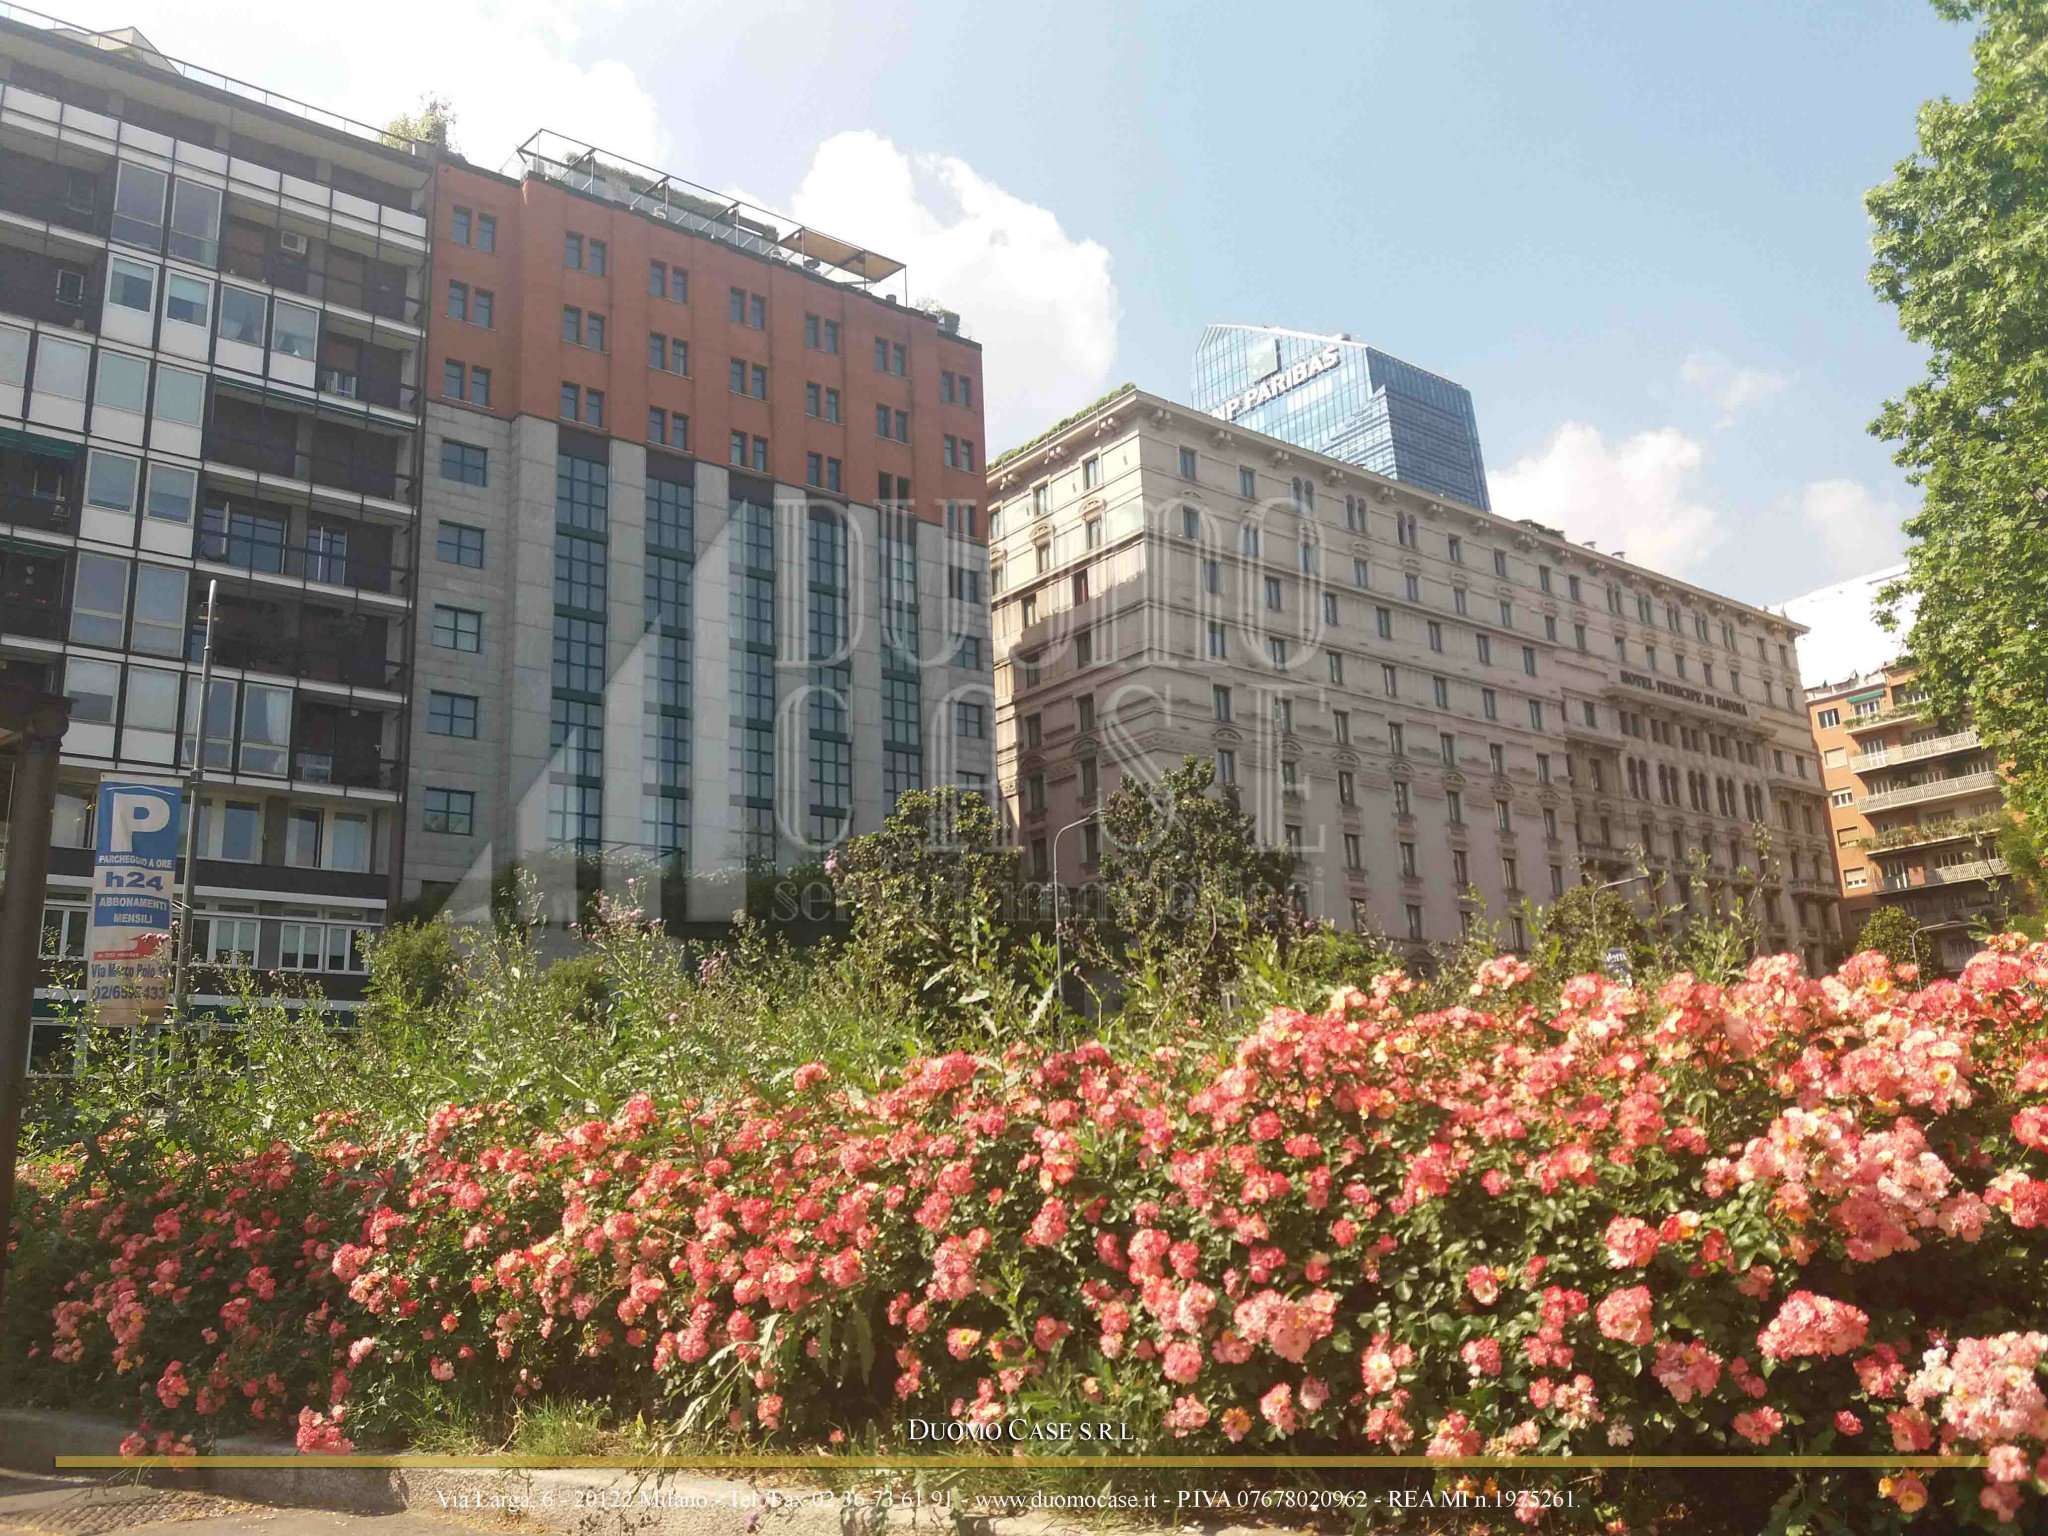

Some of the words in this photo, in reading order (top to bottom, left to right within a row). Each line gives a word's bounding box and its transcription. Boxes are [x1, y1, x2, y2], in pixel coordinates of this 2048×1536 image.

[1212, 399, 1240, 421] NP
[1242, 344, 1341, 412] PARIBAS
[110, 792, 171, 852] P
[98, 854, 147, 867] PARCHEGGIO
[148, 858, 154, 867] A
[156, 859, 172, 869] ORE
[105, 871, 163, 892] h24
[99, 896, 168, 911] ABBONAMENTI
[113, 913, 152, 925] MENSILI
[91, 963, 105, 978] Via
[108, 963, 134, 978] Mco
